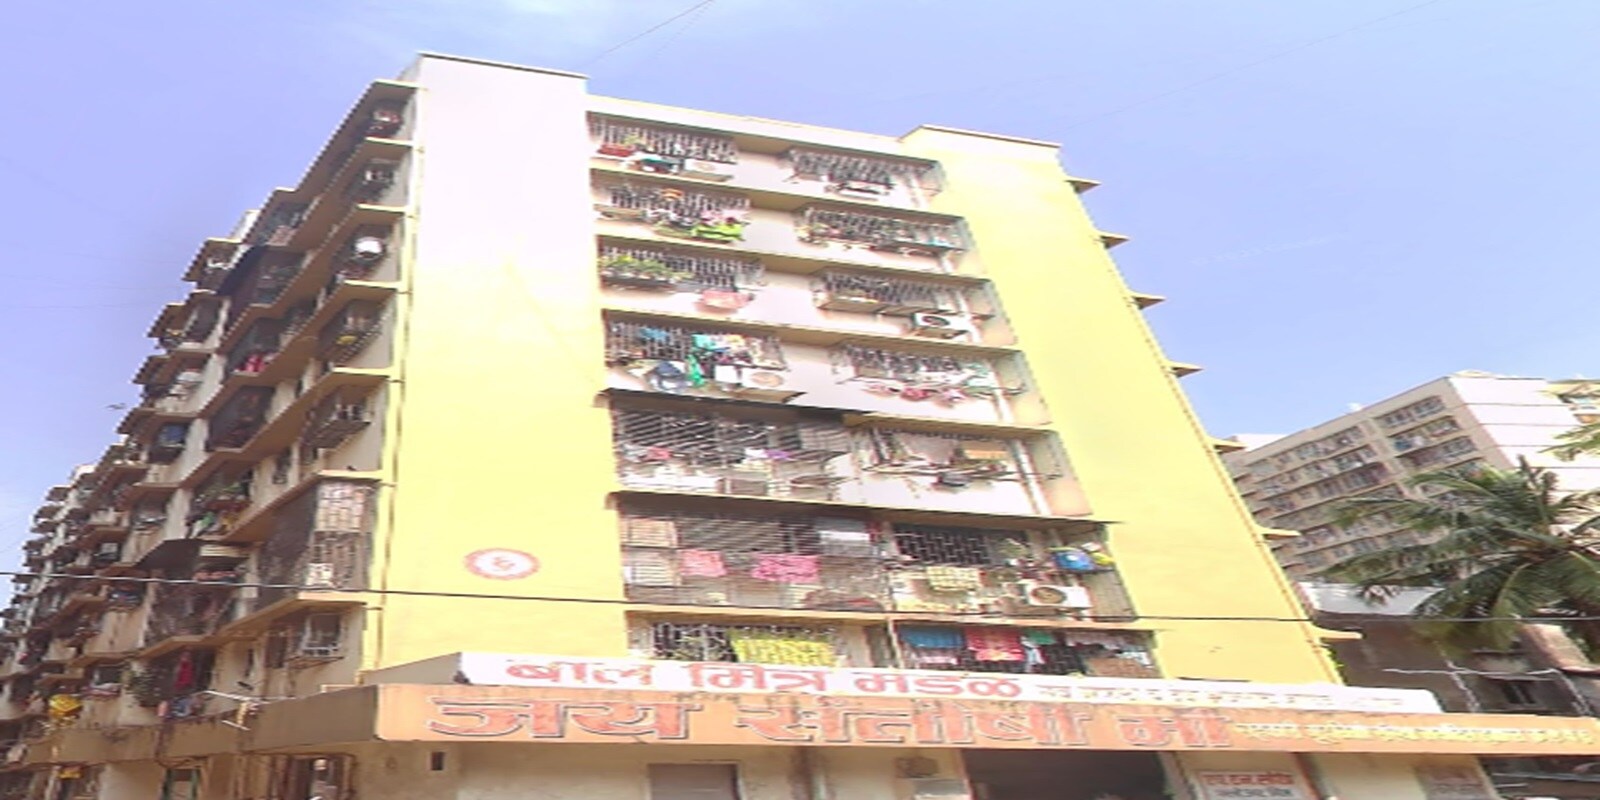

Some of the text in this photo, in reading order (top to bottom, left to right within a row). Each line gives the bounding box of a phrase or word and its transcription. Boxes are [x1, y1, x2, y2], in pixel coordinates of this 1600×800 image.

[506, 661, 655, 686] बाल
[681, 662, 830, 692] मित्र
[427, 697, 703, 740] जय
[734, 697, 1093, 746] संतोषी
